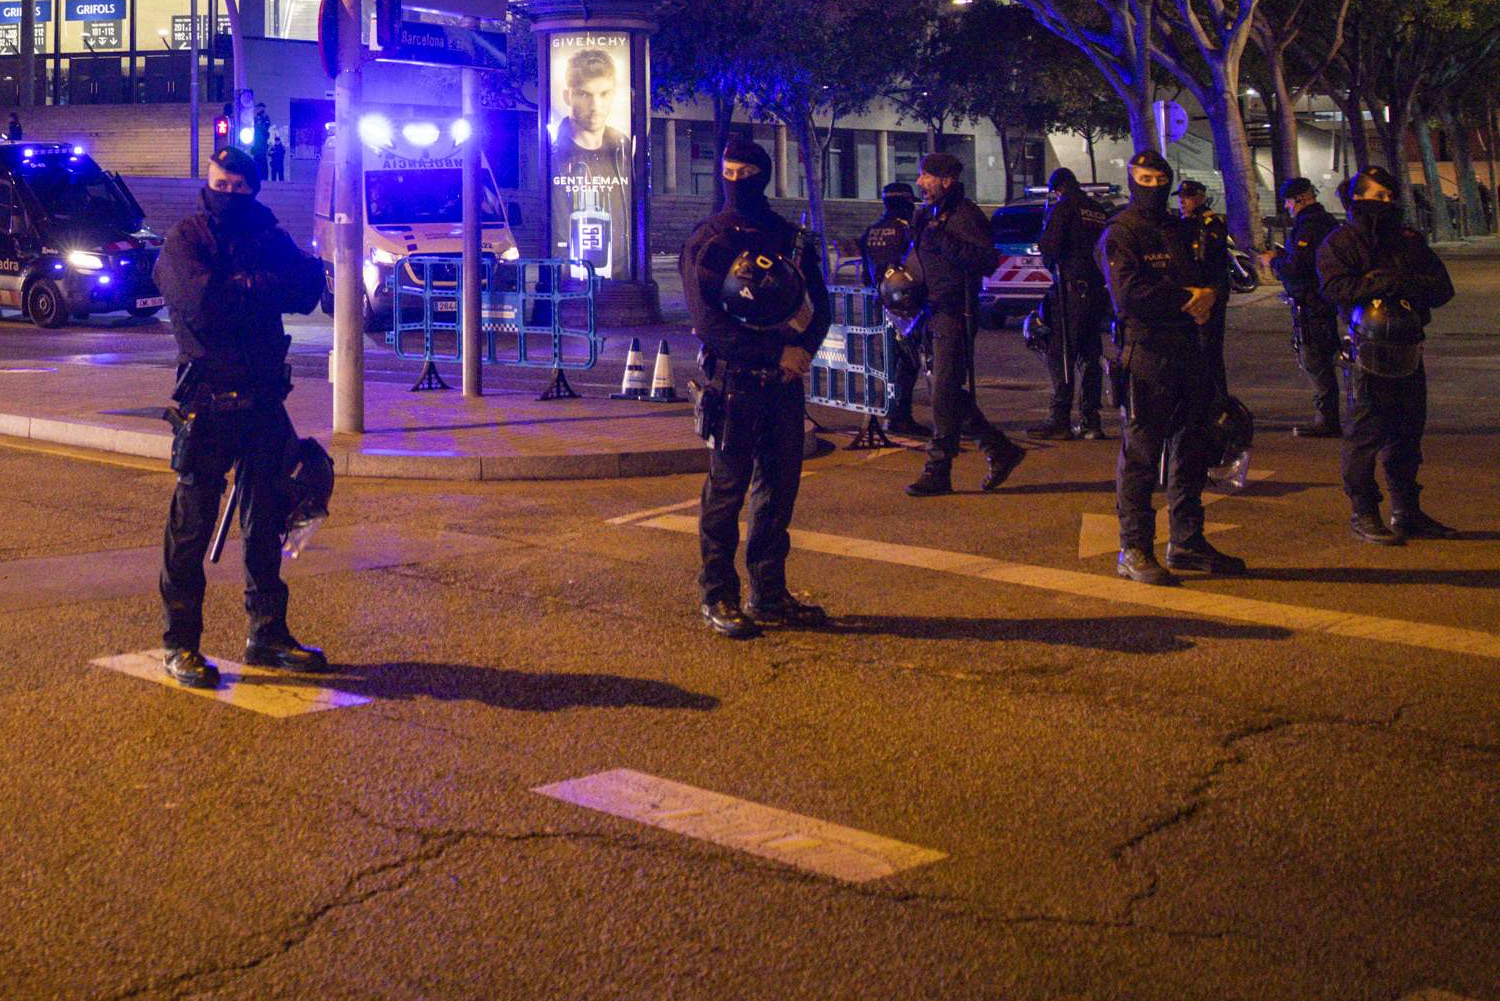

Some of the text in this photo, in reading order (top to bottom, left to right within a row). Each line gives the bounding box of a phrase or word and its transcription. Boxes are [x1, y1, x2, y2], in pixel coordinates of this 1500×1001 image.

[76, 4, 116, 15] GRIFOLS
[401, 30, 445, 48] Barcelona
[552, 36, 627, 48] GIVENCHY
[553, 176, 629, 185] GENTLEMAN
[565, 185, 614, 193] SOCIETY
